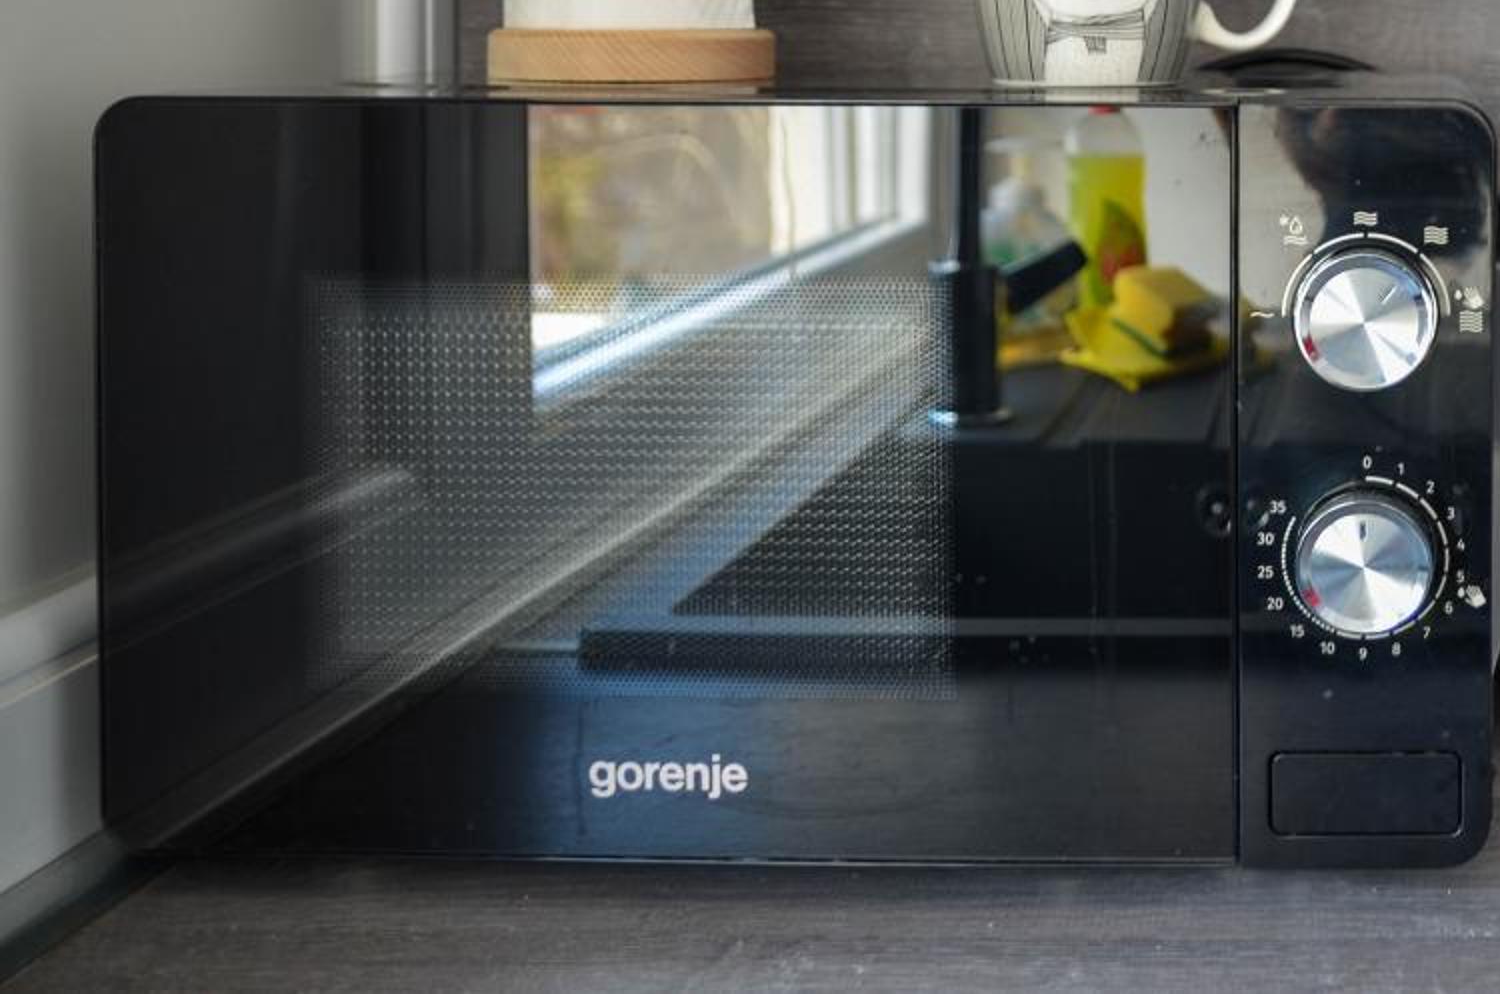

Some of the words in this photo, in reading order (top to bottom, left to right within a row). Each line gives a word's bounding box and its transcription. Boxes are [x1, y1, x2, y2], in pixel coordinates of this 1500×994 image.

[1362, 456, 1373, 470] 0
[1397, 462, 1405, 475] 1
[1425, 480, 1437, 494] 2
[1269, 500, 1287, 515] 35
[1447, 507, 1456, 520] 3
[1256, 532, 1275, 546] 30
[1456, 538, 1466, 551] 4
[1256, 565, 1275, 580] 25
[1456, 570, 1466, 584] 5
[1266, 597, 1285, 611] 20
[1444, 601, 1454, 615] 6
[1289, 624, 1305, 639] 15
[1423, 625, 1432, 639] 7
[1319, 642, 1336, 656] 10
[1358, 647, 1369, 662] 9
[1391, 641, 1402, 656] 8
[588, 753, 749, 800] gorenje
